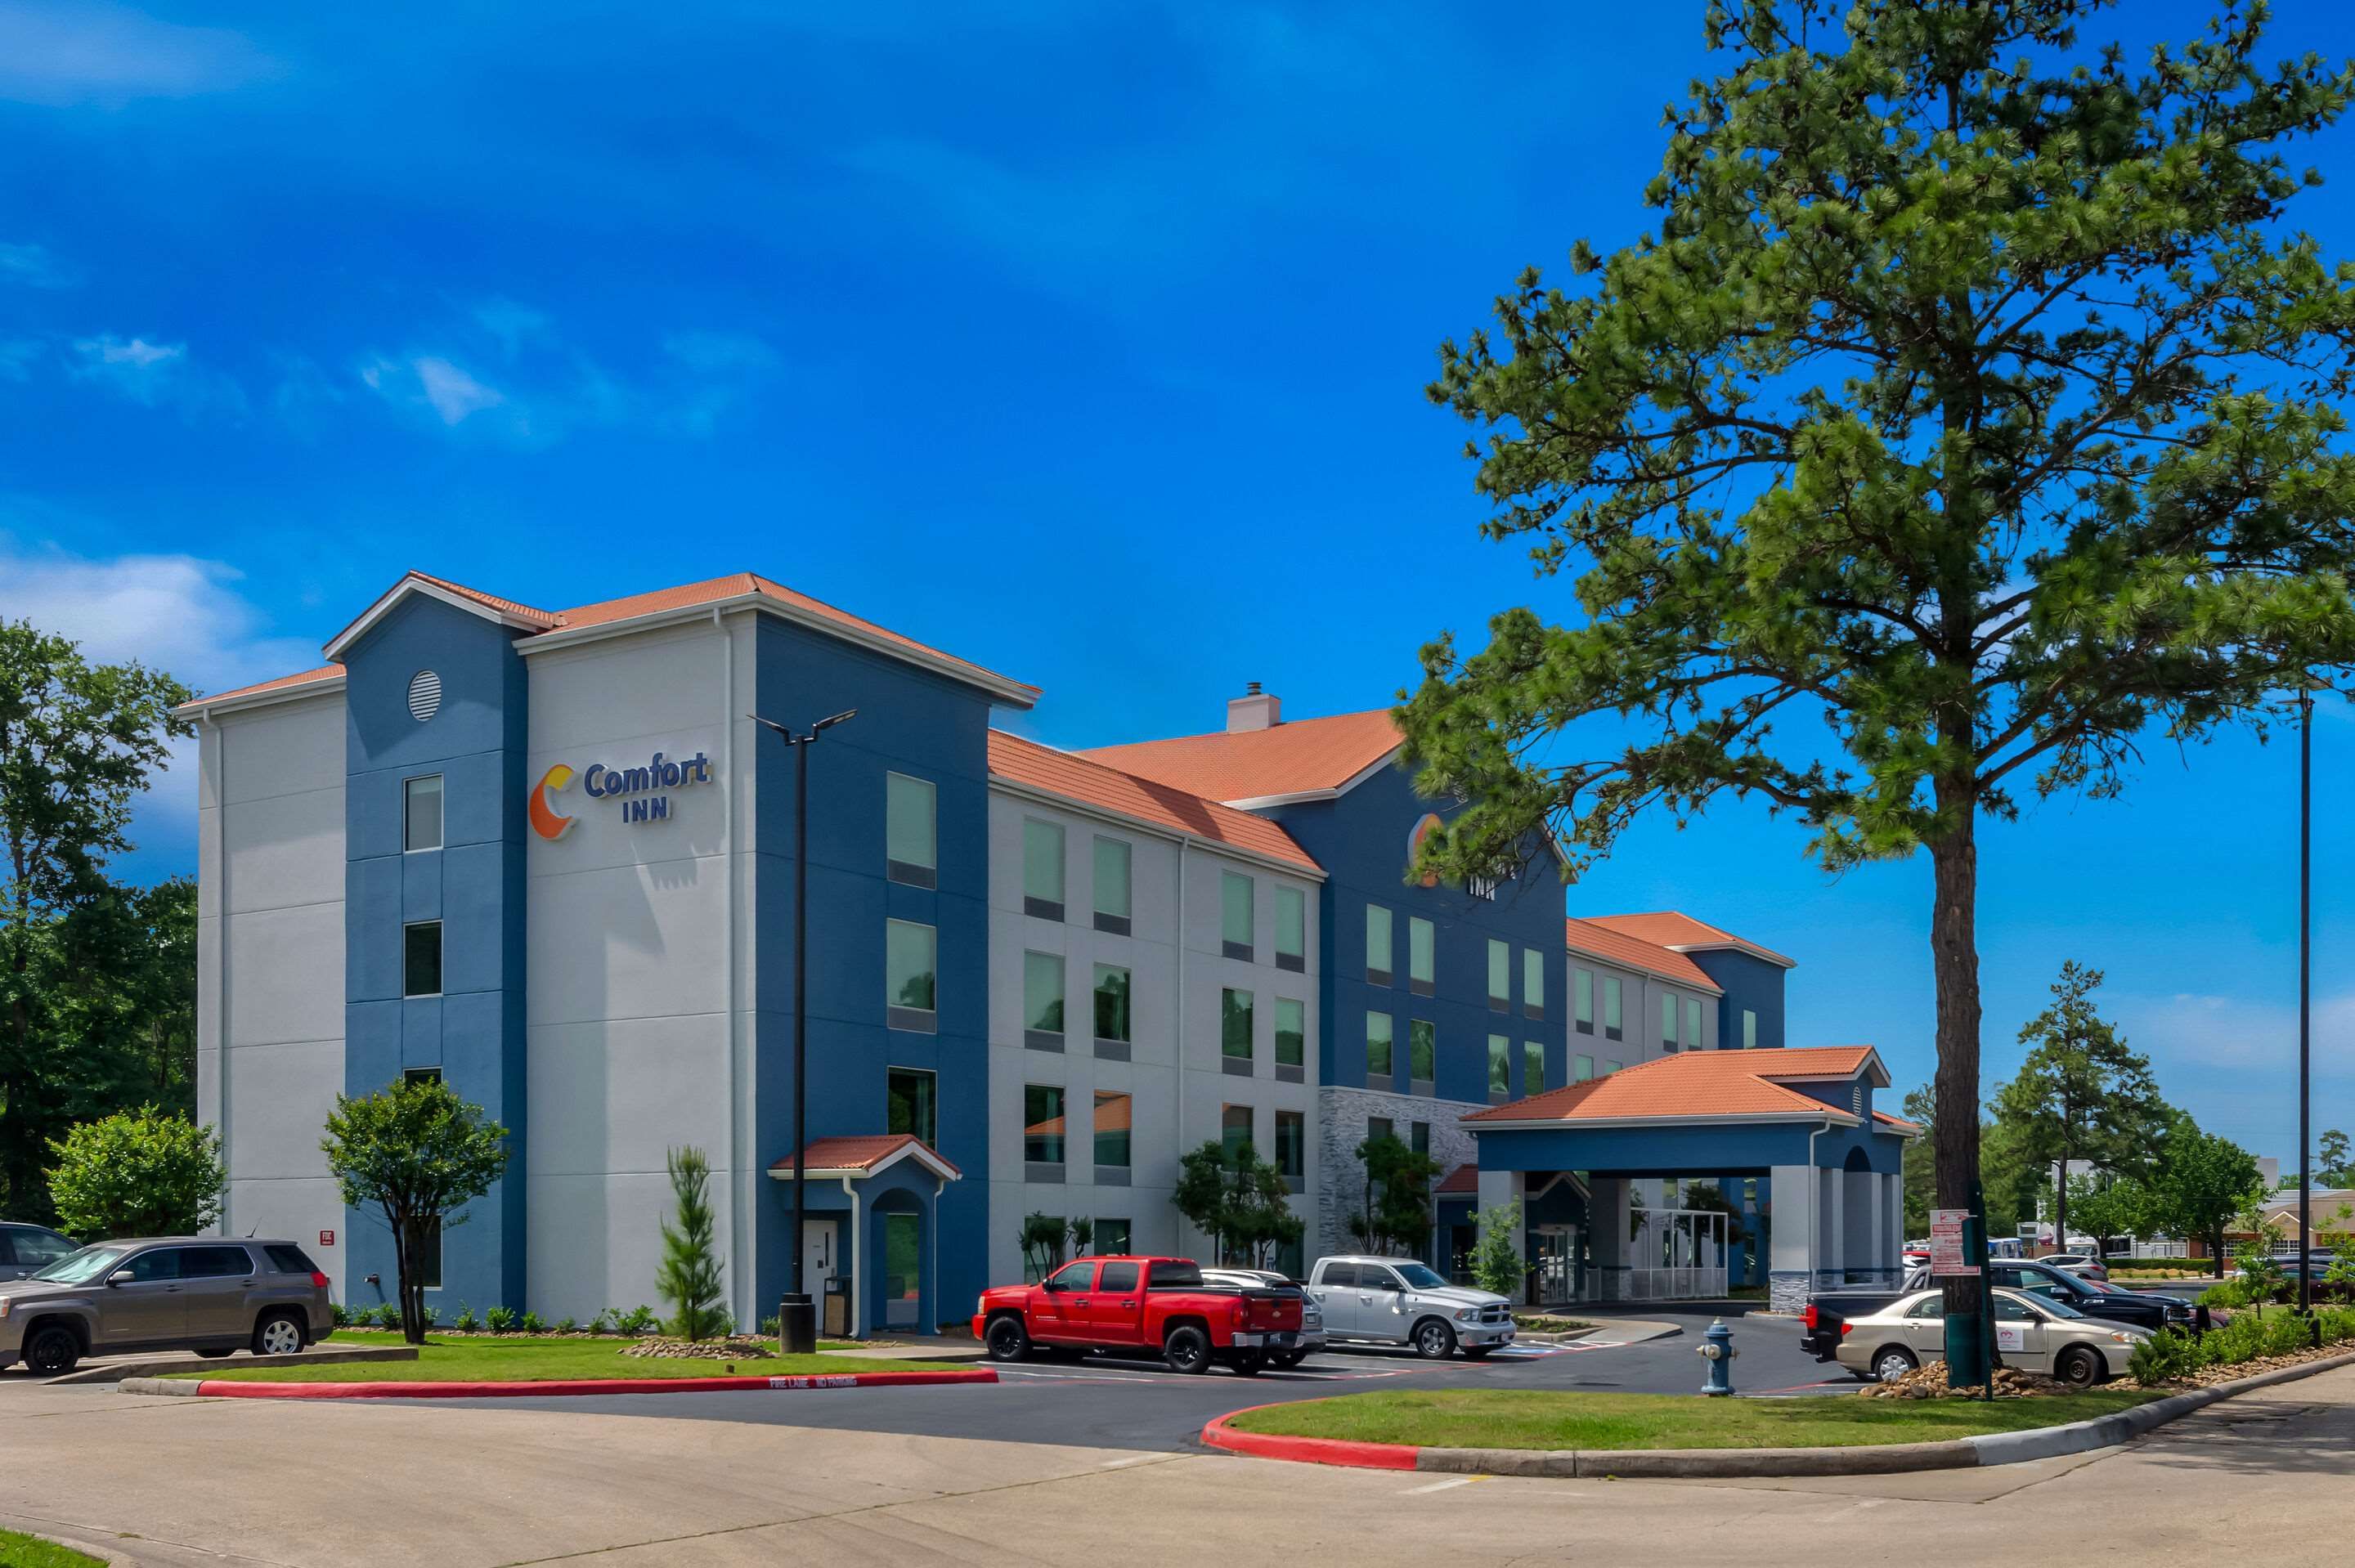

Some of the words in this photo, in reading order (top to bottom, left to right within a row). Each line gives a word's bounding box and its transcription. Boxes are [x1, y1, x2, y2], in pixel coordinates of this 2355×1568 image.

[584, 751, 709, 798] Comfort
[622, 795, 668, 823] INN
[769, 1378, 787, 1388] FIRE
[788, 1378, 809, 1388] LANE
[815, 1377, 827, 1387] NO
[828, 1376, 857, 1387] PARKING
